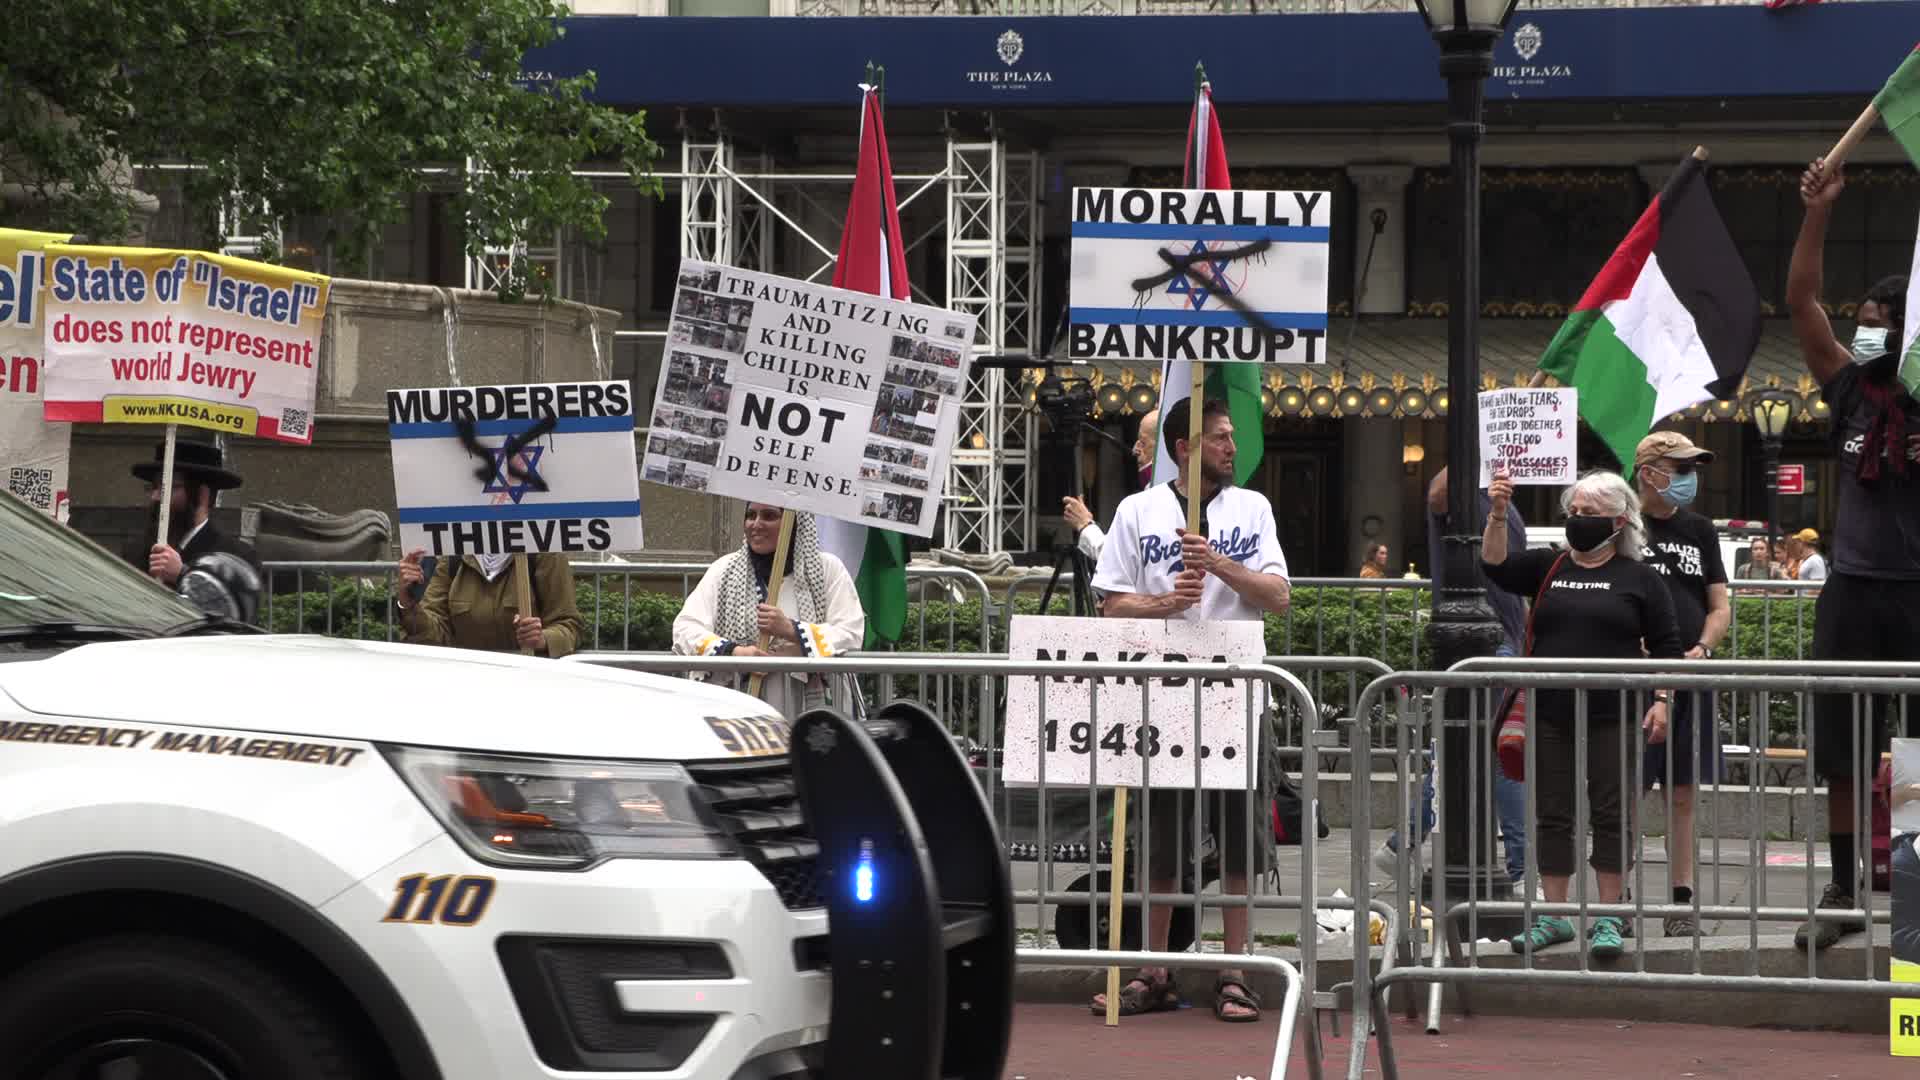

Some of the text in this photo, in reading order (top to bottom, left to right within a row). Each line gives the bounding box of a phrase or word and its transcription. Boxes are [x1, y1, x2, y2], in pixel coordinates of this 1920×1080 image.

[967, 71, 1052, 82] THE PLAZA
[1493, 66, 1572, 77] HE PLAZA
[1076, 188, 1322, 227] MORALLY
[53, 257, 318, 326] State of "Israel"
[727, 276, 929, 335] TRAUMATIZING
[53, 313, 314, 369] does not represent
[783, 312, 831, 335] AND
[760, 328, 867, 365] KILLING
[1069, 324, 1326, 363] BANKRUPT
[111, 352, 257, 399] world Jewry
[744, 350, 872, 391] CHILDREN
[787, 378, 808, 397] IS
[122, 403, 245, 430] www.NKUSA.org
[387, 383, 630, 424] MURDERERS
[740, 392, 845, 444] NOT
[1506, 406, 1535, 418] DROPS
[753, 436, 815, 463] SELF
[1497, 444, 1523, 457] STOP
[1512, 433, 1542, 446] FLOOD
[725, 455, 857, 498] DEFENSE.
[1507, 456, 1568, 469] MASSACRES
[423, 519, 612, 556] THIEVES
[1551, 579, 1611, 591] PALESTINE
[1035, 648, 1235, 688] NAKBA
[152, 732, 366, 767] MANAGEMENT
[382, 873, 497, 927] 110
